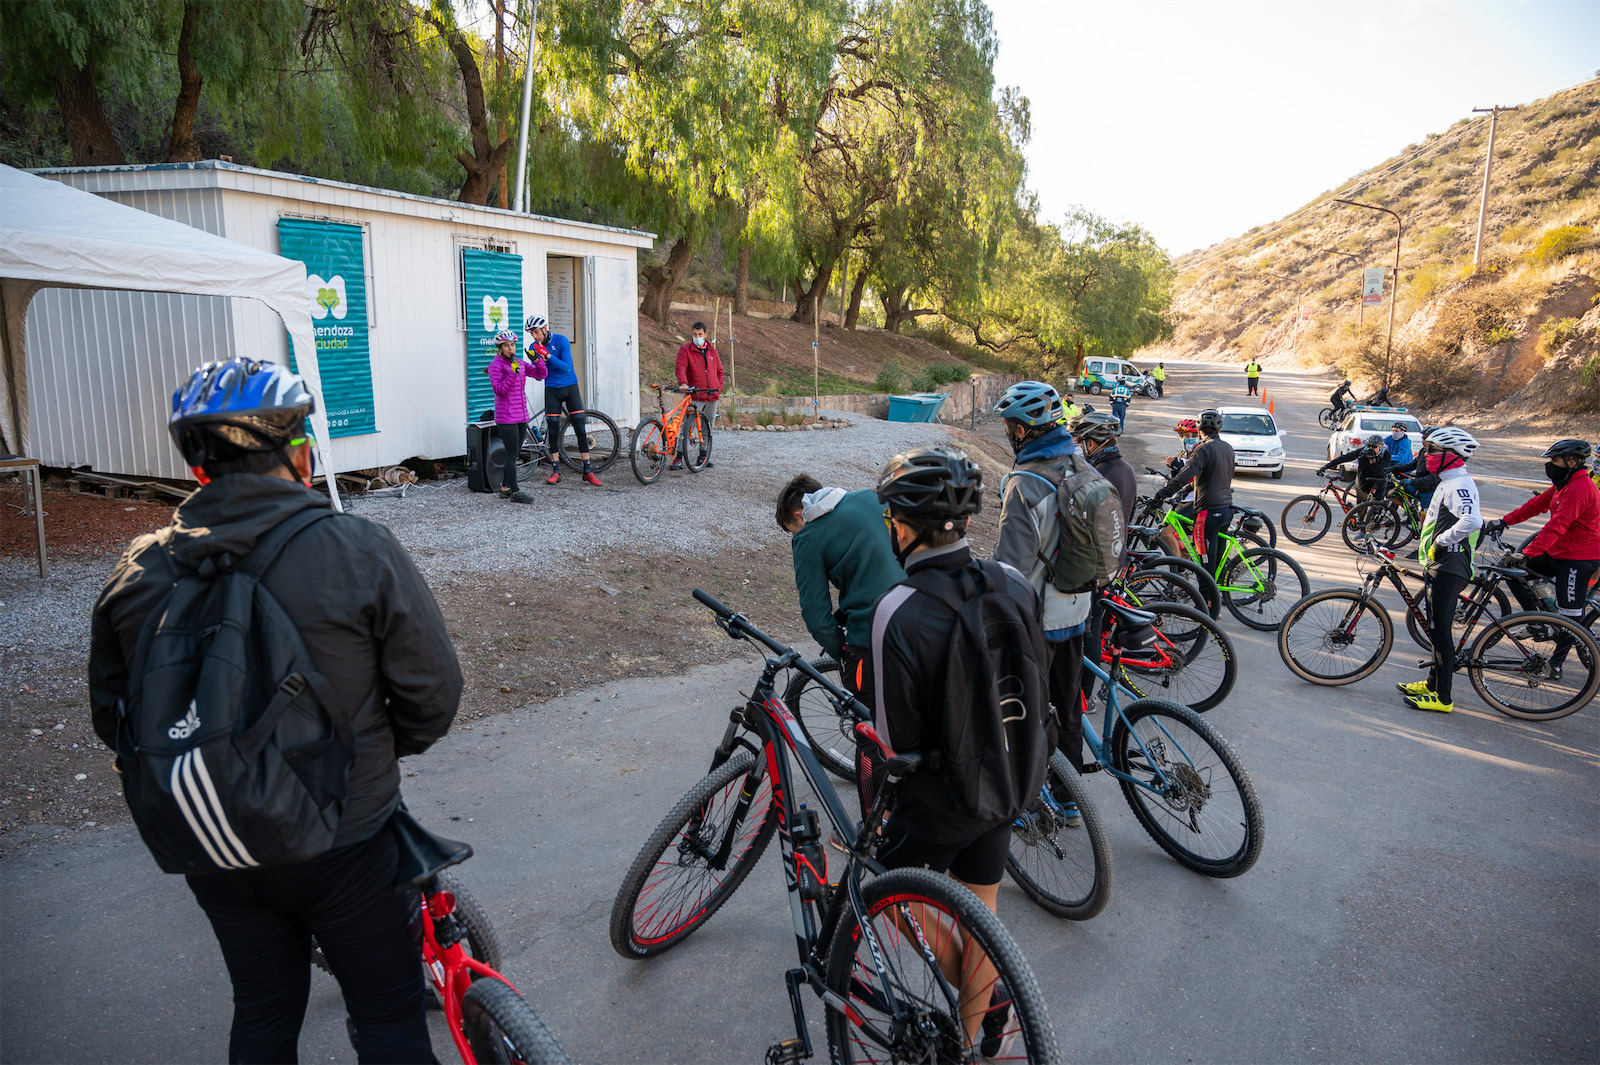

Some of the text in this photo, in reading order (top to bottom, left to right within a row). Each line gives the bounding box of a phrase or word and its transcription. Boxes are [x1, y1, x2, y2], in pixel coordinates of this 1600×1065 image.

[315, 338, 348, 350] ciudad
[1567, 568, 1578, 602] TREK
[772, 784, 800, 892] VOLTA
[862, 915, 885, 973] VOLTA
